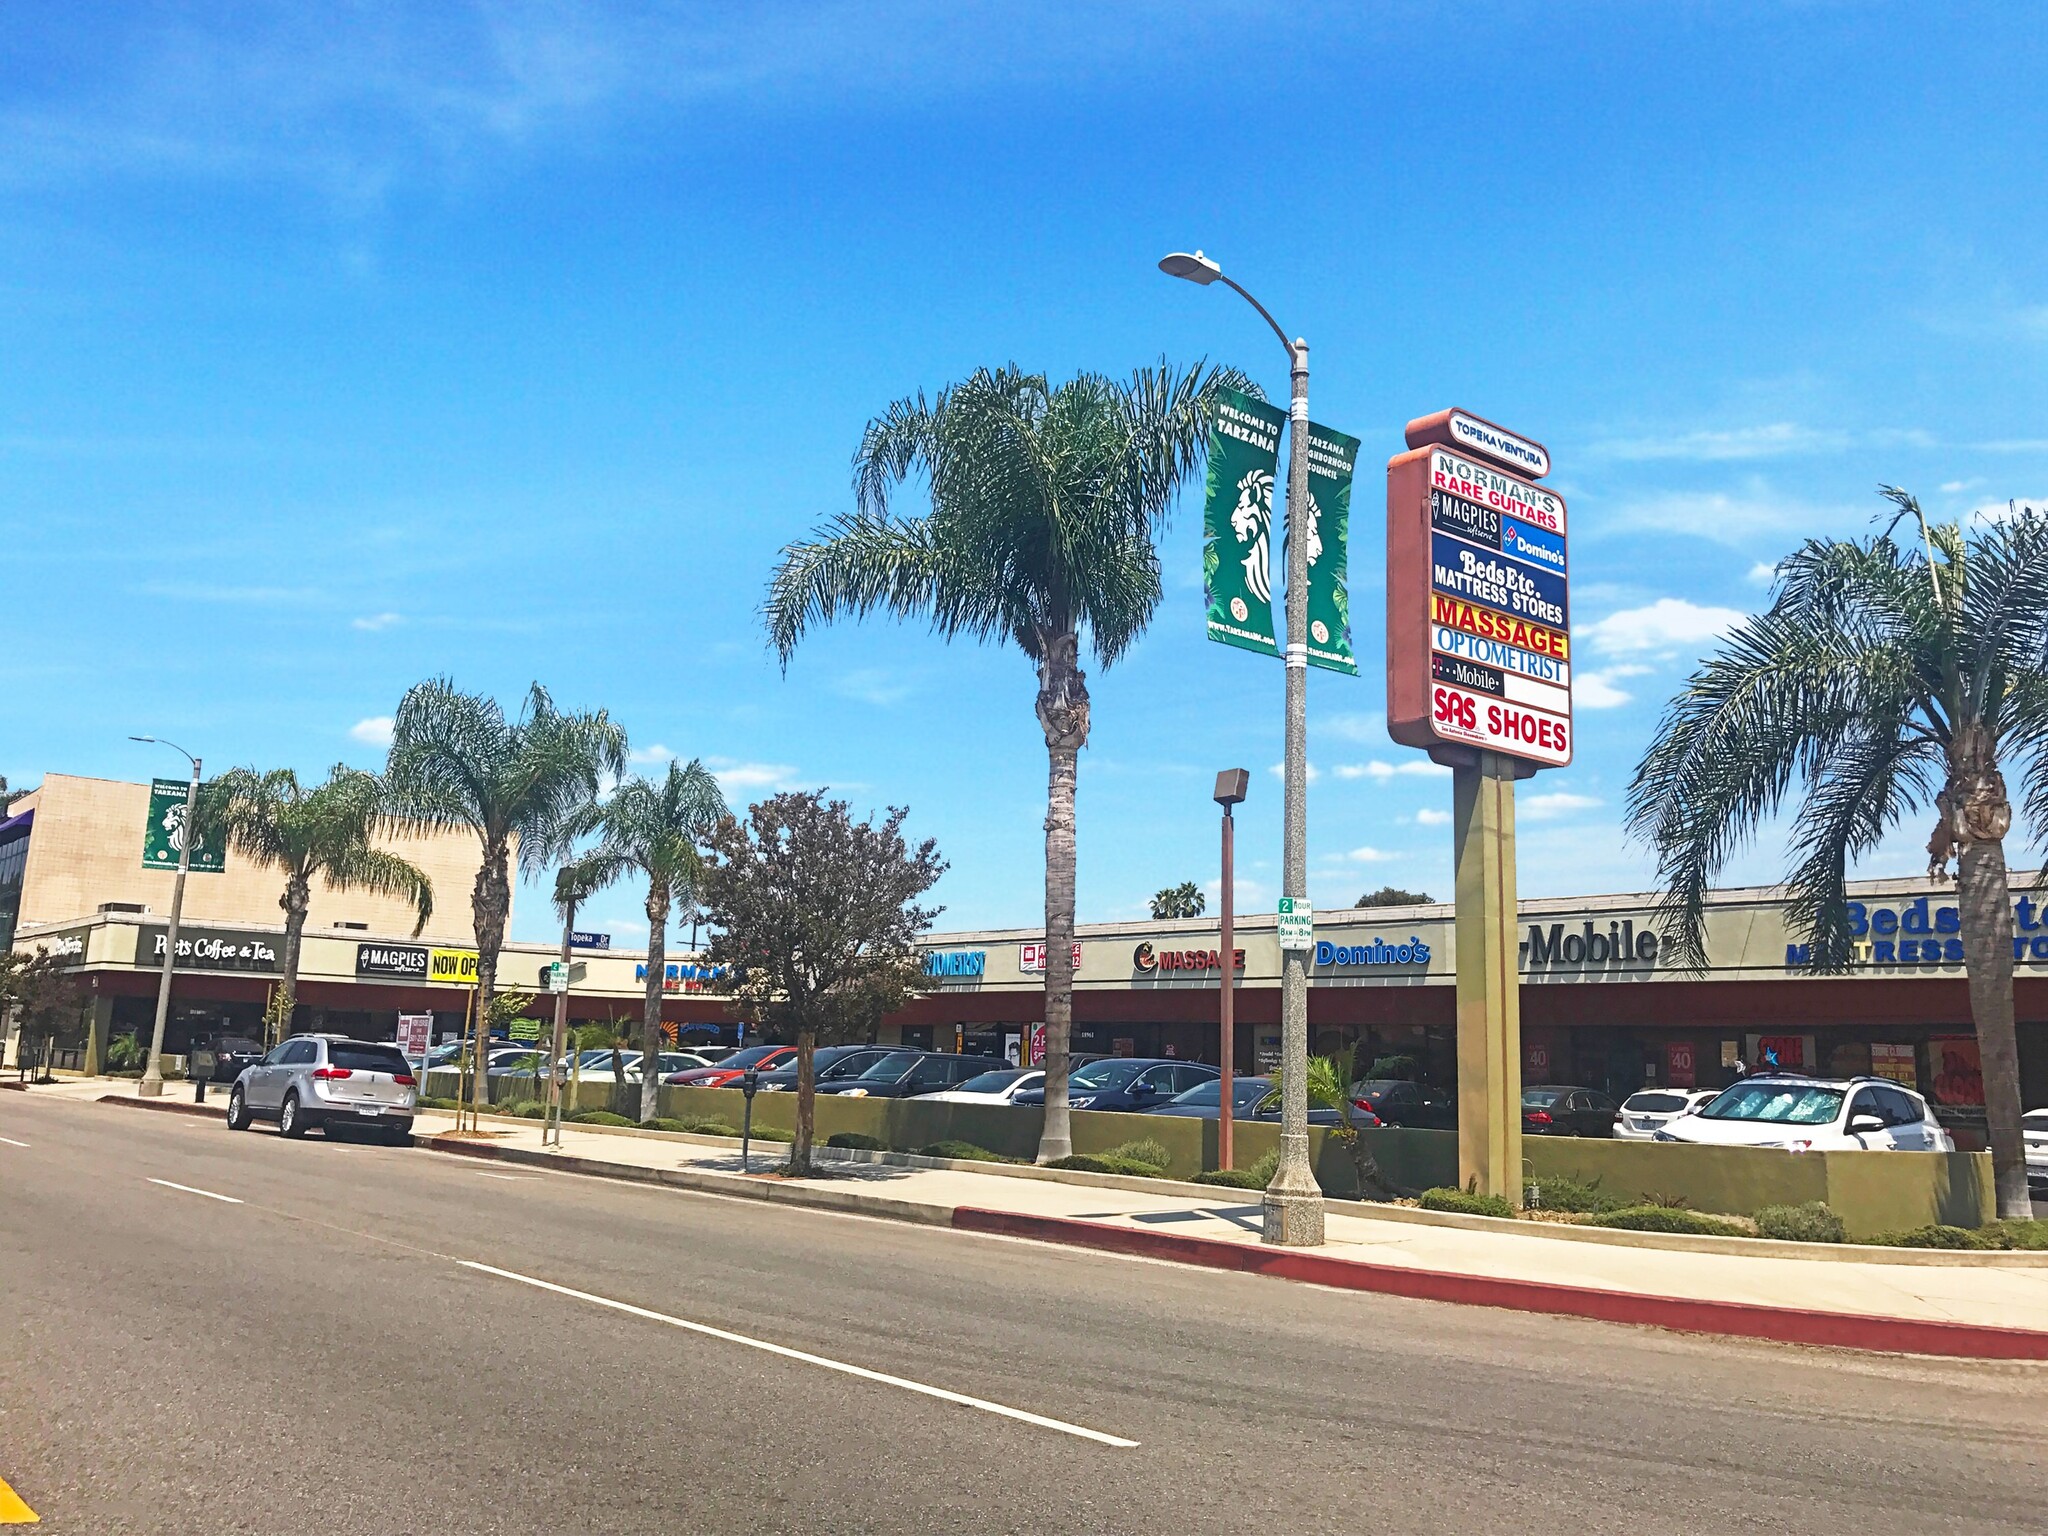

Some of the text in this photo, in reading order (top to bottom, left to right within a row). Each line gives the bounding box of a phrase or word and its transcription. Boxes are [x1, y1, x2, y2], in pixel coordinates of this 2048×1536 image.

[1220, 404, 1278, 436] WELCOME TO
[1217, 419, 1274, 453] TARZANA
[1456, 420, 1542, 466] TOPEKA VENTURA
[1308, 450, 1352, 472] GHBORHOOD
[1308, 462, 1338, 480] COUNCIL
[1440, 456, 1555, 513] NORMAN'S
[1435, 471, 1557, 529] RARE GUITARS
[1442, 495, 1498, 532] MAGPIES
[1517, 536, 1564, 566] Domino's
[1460, 550, 1541, 598] Beds Etc.
[1434, 564, 1563, 624] MATTRESS STORES
[1436, 598, 1563, 657] MASSAGE
[1438, 628, 1562, 682] OPTOMETRIST
[1434, 688, 1566, 751] SAS SHOES
[1280, 916, 1311, 925] PARKING
[1282, 900, 1288, 911] 2
[194, 938, 236, 960] Coffee
[239, 946, 252, 957] &
[251, 942, 275, 961] Tea
[570, 932, 592, 943] Topeka
[1316, 936, 1430, 965] Domino's
[1786, 938, 1964, 964] MTRESS
[371, 950, 425, 967] MAGPIES
[433, 956, 480, 976] NOW OP
[1159, 948, 1246, 969] MASSAE
